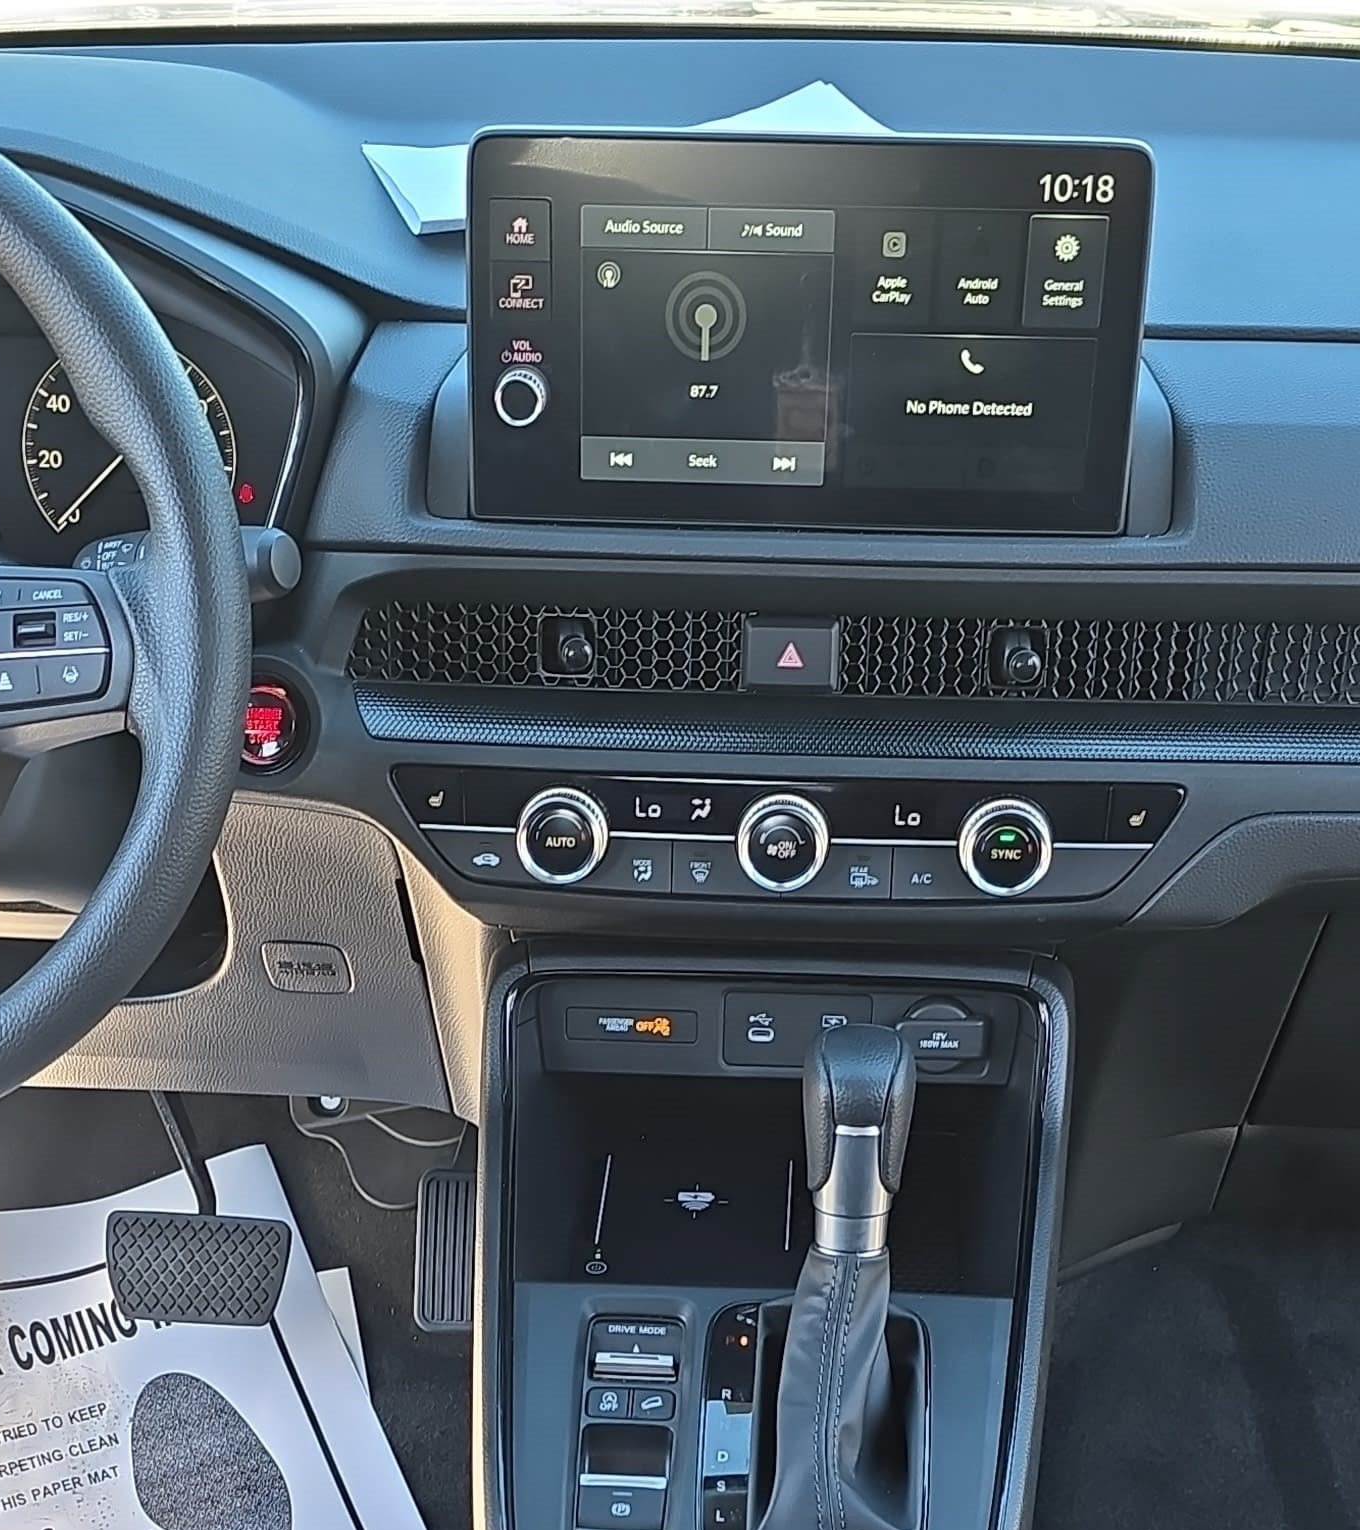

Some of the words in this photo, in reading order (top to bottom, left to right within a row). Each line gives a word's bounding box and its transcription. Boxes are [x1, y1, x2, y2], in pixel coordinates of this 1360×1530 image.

[1039, 174, 1115, 203] 10:18
[605, 219, 641, 234] Audio
[642, 220, 684, 235] Source
[765, 223, 803, 237] Sound
[505, 233, 535, 244] HOME
[877, 276, 908, 290] Apple
[957, 277, 999, 290] Android
[1044, 279, 1084, 292] General
[498, 297, 545, 309] CONNECT
[871, 291, 912, 306] CarPlay
[963, 293, 989, 305] Auto
[1042, 295, 1084, 308] Settings
[512, 340, 532, 350] VOL
[512, 352, 542, 363] AUDIO
[690, 385, 719, 399] 87.7
[46, 395, 70, 413] 40
[906, 400, 924, 414] No
[928, 401, 970, 415] Phone
[972, 402, 1033, 416] Detected
[38, 450, 63, 468] 20
[688, 454, 718, 468] Seek
[102, 550, 118, 560] OFF
[32, 589, 63, 600] CANCEL
[246, 720, 279, 730] START
[634, 796, 662, 819] Lo
[895, 804, 921, 827] Lo
[545, 836, 576, 848] AUTO
[777, 849, 797, 859] OFF
[990, 848, 1022, 861] SYNC
[690, 861, 712, 869] FRONT
[910, 872, 933, 885] A/C
[635, 1021, 656, 1031] OFF
[940, 1040, 959, 1049] MAX
[7, 1298, 138, 1370] COMING
[608, 1324, 636, 1334] DRIVE
[639, 1326, 667, 1335] MODE
[721, 1388, 732, 1400] R
[599, 1402, 618, 1412] OFF
[40, 1416, 63, 1432] TO
[67, 1402, 107, 1425] KEEP
[68, 1432, 120, 1457] CLEAN
[717, 1450, 729, 1462] D
[30, 1476, 83, 1502] PAPER
[86, 1464, 120, 1486] MAT
[716, 1480, 726, 1492] S
[715, 1509, 725, 1522] L
